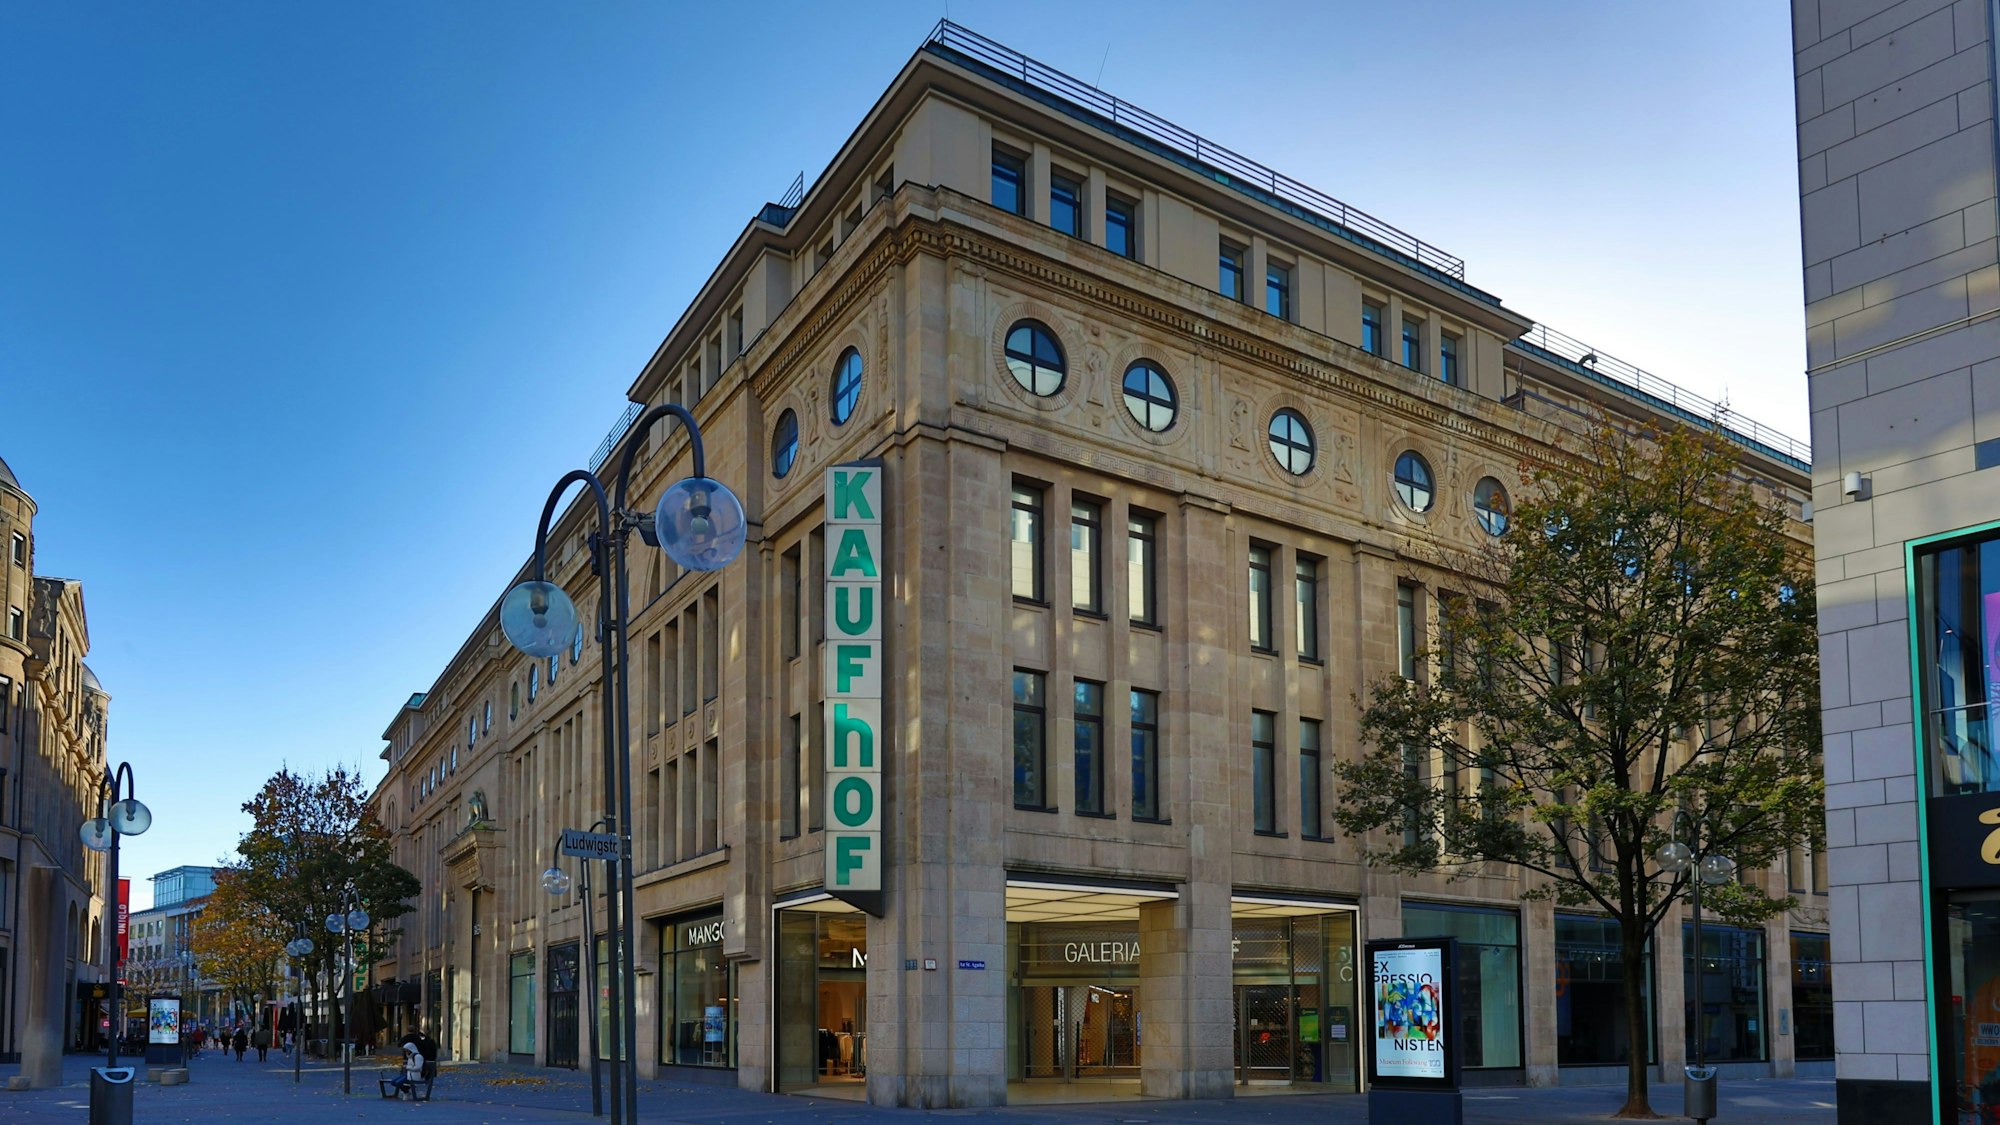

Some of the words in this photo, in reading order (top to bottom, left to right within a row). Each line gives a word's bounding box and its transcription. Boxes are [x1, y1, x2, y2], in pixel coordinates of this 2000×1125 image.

[565, 833, 618, 856] Ludwigstr.
[117, 903, 128, 935] UNIQLO
[1064, 942, 1141, 963] GALERIA
